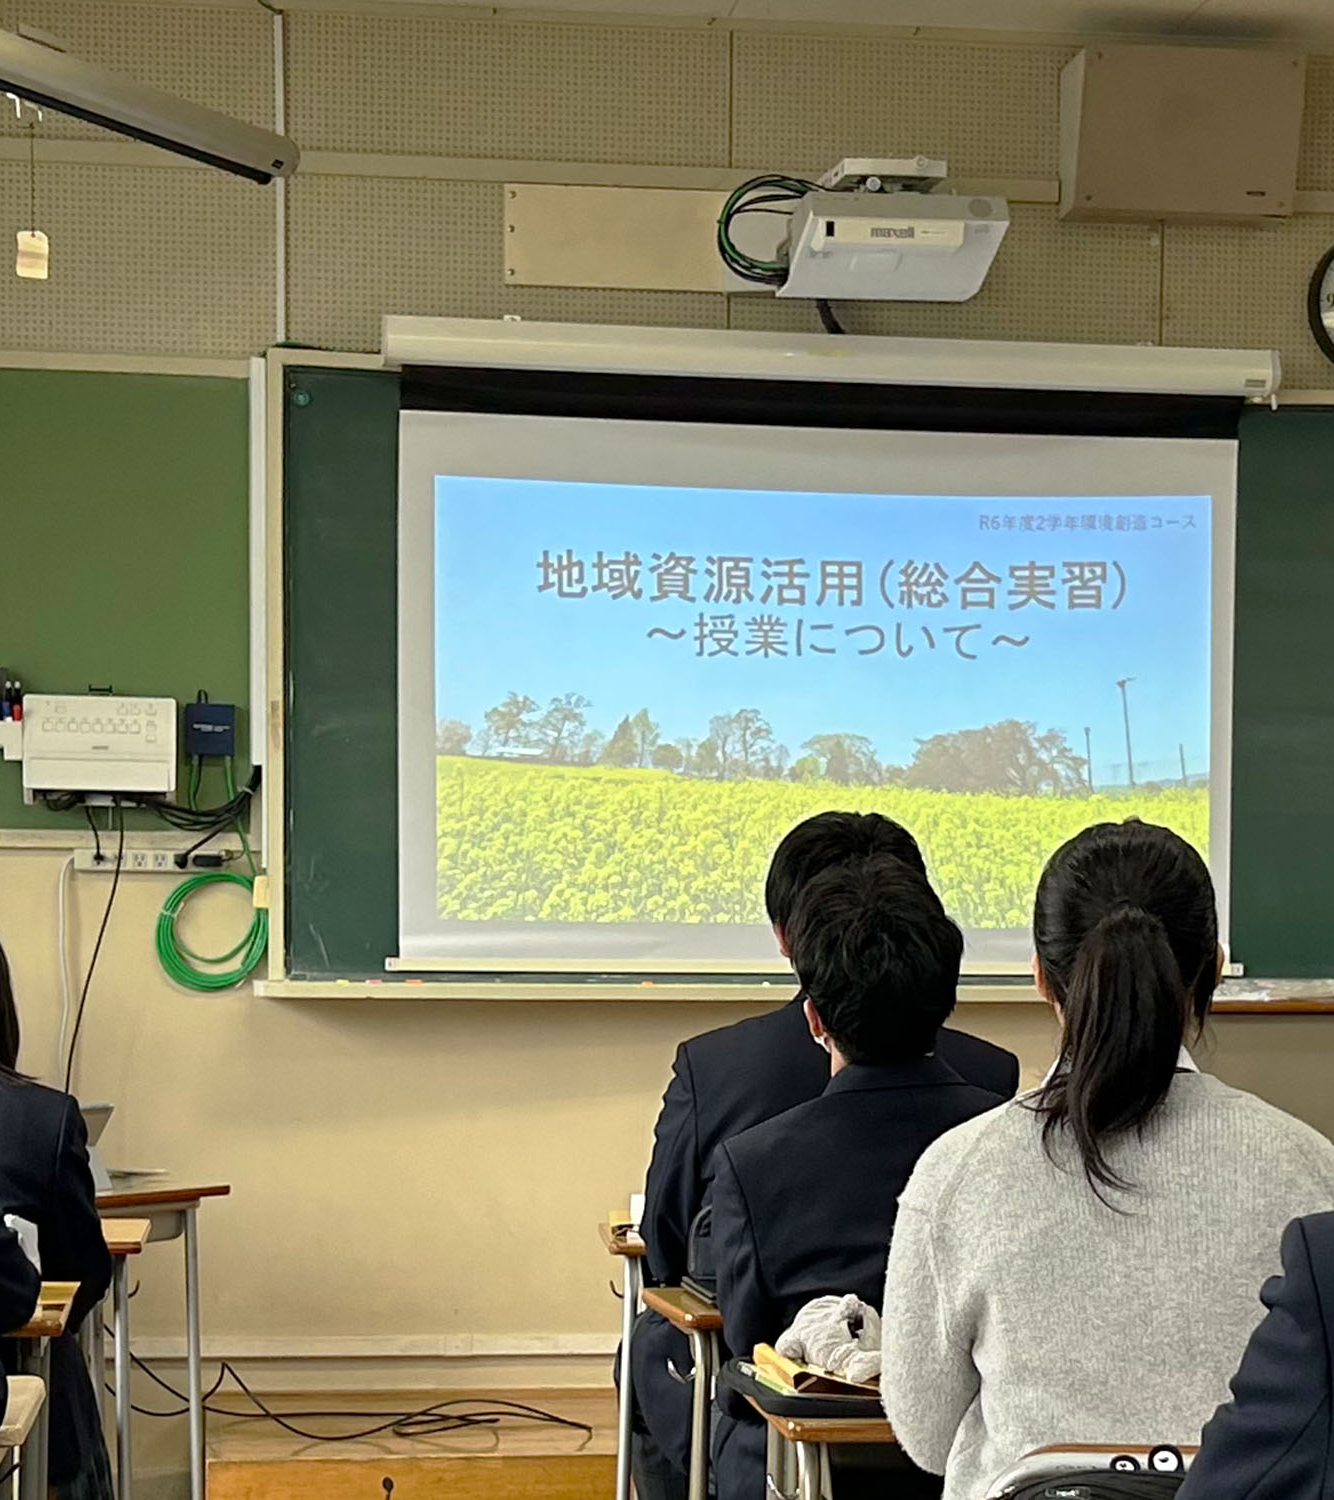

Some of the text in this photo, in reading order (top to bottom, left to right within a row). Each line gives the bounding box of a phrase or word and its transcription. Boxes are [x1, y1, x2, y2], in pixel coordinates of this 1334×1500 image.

[870, 226, 915, 239] maxell
[978, 514, 1197, 533] R6年度2学年環境創造コース
[535, 548, 1128, 611] 地域資源活用（総合実習）
